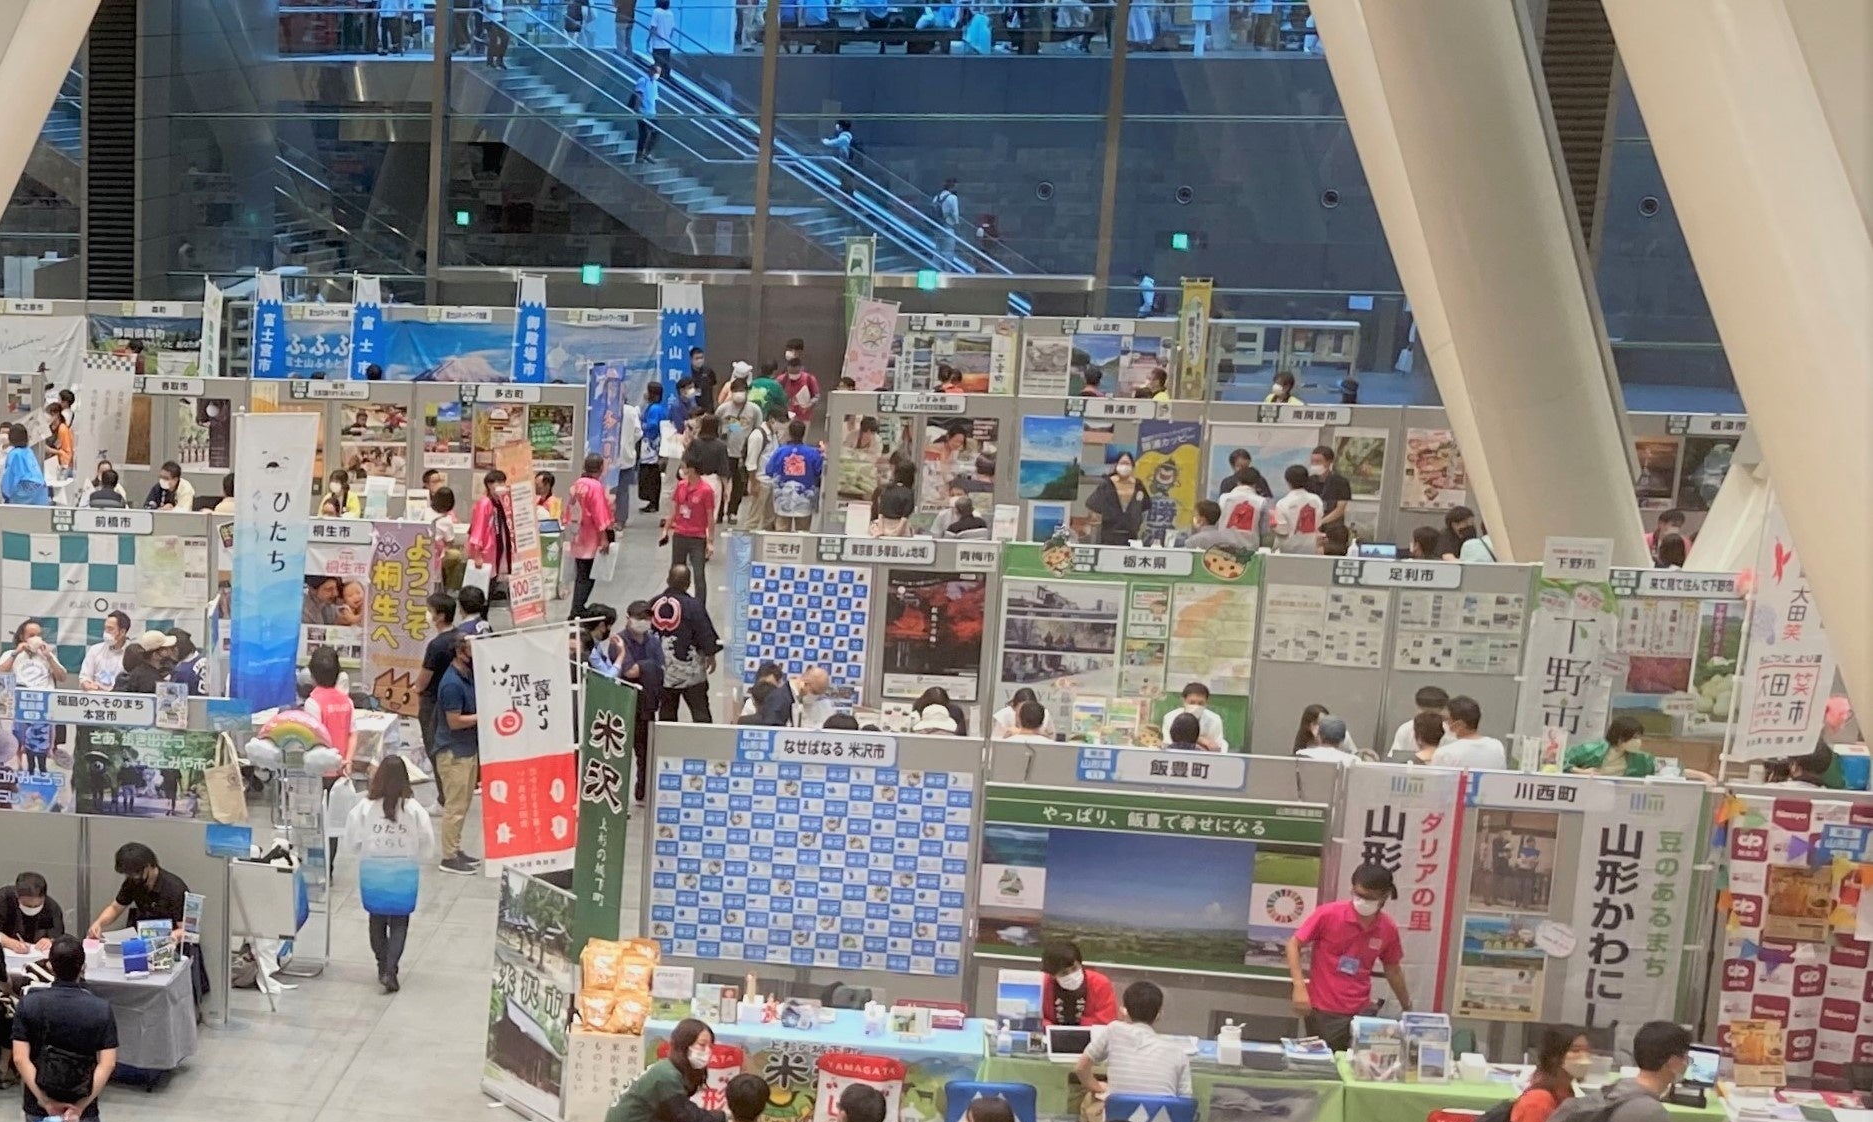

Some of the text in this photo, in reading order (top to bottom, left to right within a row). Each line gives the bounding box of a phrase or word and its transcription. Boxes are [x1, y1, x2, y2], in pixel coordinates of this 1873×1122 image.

[495, 389, 523, 399] 多古町
[95, 516, 132, 529] 前橋市
[268, 490, 292, 574] ひたち
[313, 525, 350, 538] 桐生市
[766, 543, 800, 554] 三宅村
[1123, 556, 1167, 570] 栃木県
[1556, 557, 1596, 570] 下野市
[1389, 568, 1434, 582] 足利市
[404, 533, 432, 641] ようこそ
[372, 560, 402, 650] 桐生へ
[1544, 616, 1595, 734] 下野市
[56, 695, 144, 711] 福島のへそのまち
[83, 709, 117, 722] 本宮市
[783, 739, 886, 760] なせばなる 米沢市
[580, 709, 627, 815] 米沢
[1149, 761, 1210, 780] 飯豊町
[1514, 782, 1578, 804] 川西町
[1043, 806, 1266, 837] やっぱり、飯豊で幸せになる
[1407, 812, 1443, 932] ダリアの里
[1644, 830, 1684, 978] 豆のあるまち
[495, 961, 563, 1020] 米沢市
[827, 1060, 897, 1076] YAMAGATA
